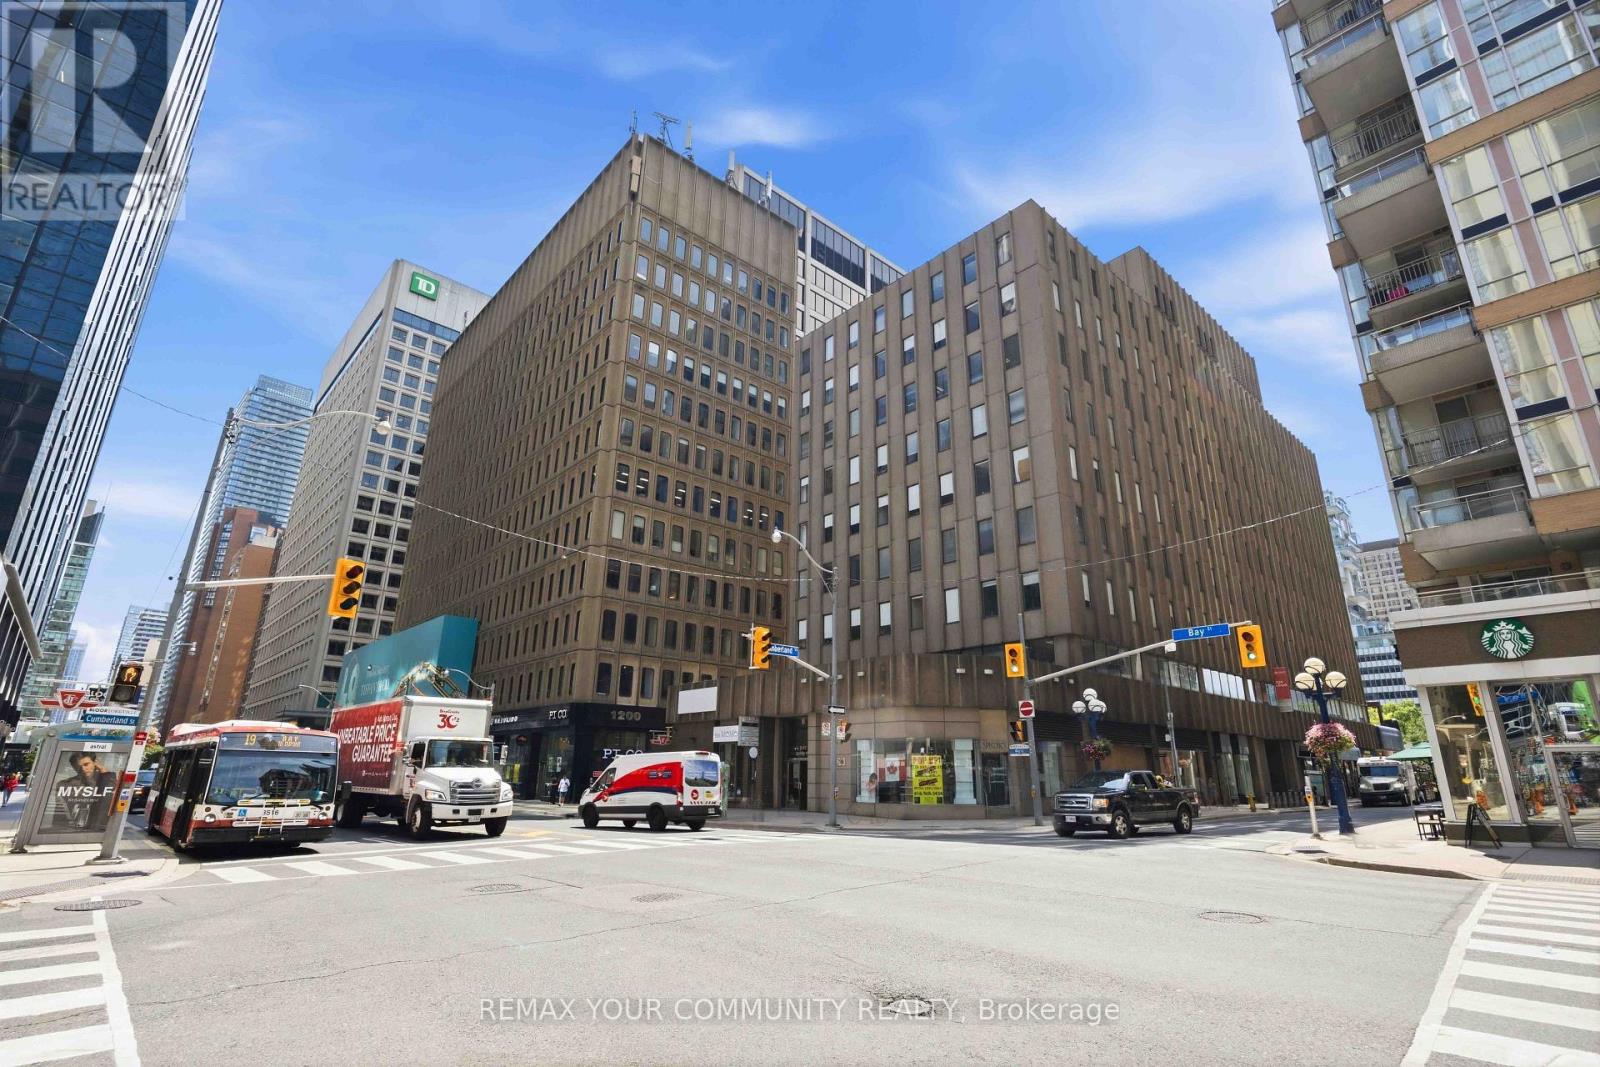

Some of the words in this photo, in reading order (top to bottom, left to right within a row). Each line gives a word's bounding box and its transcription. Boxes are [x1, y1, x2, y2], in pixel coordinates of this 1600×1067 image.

[415, 276, 436, 294] TD
[1188, 628, 1204, 638] Bay
[86, 714, 128, 724] Cumberland
[610, 710, 641, 721] 1200
[374, 723, 397, 743] PRICE
[244, 734, 257, 746] 19
[352, 743, 393, 763] GUARANTEE
[57, 786, 114, 797] MYSLF
